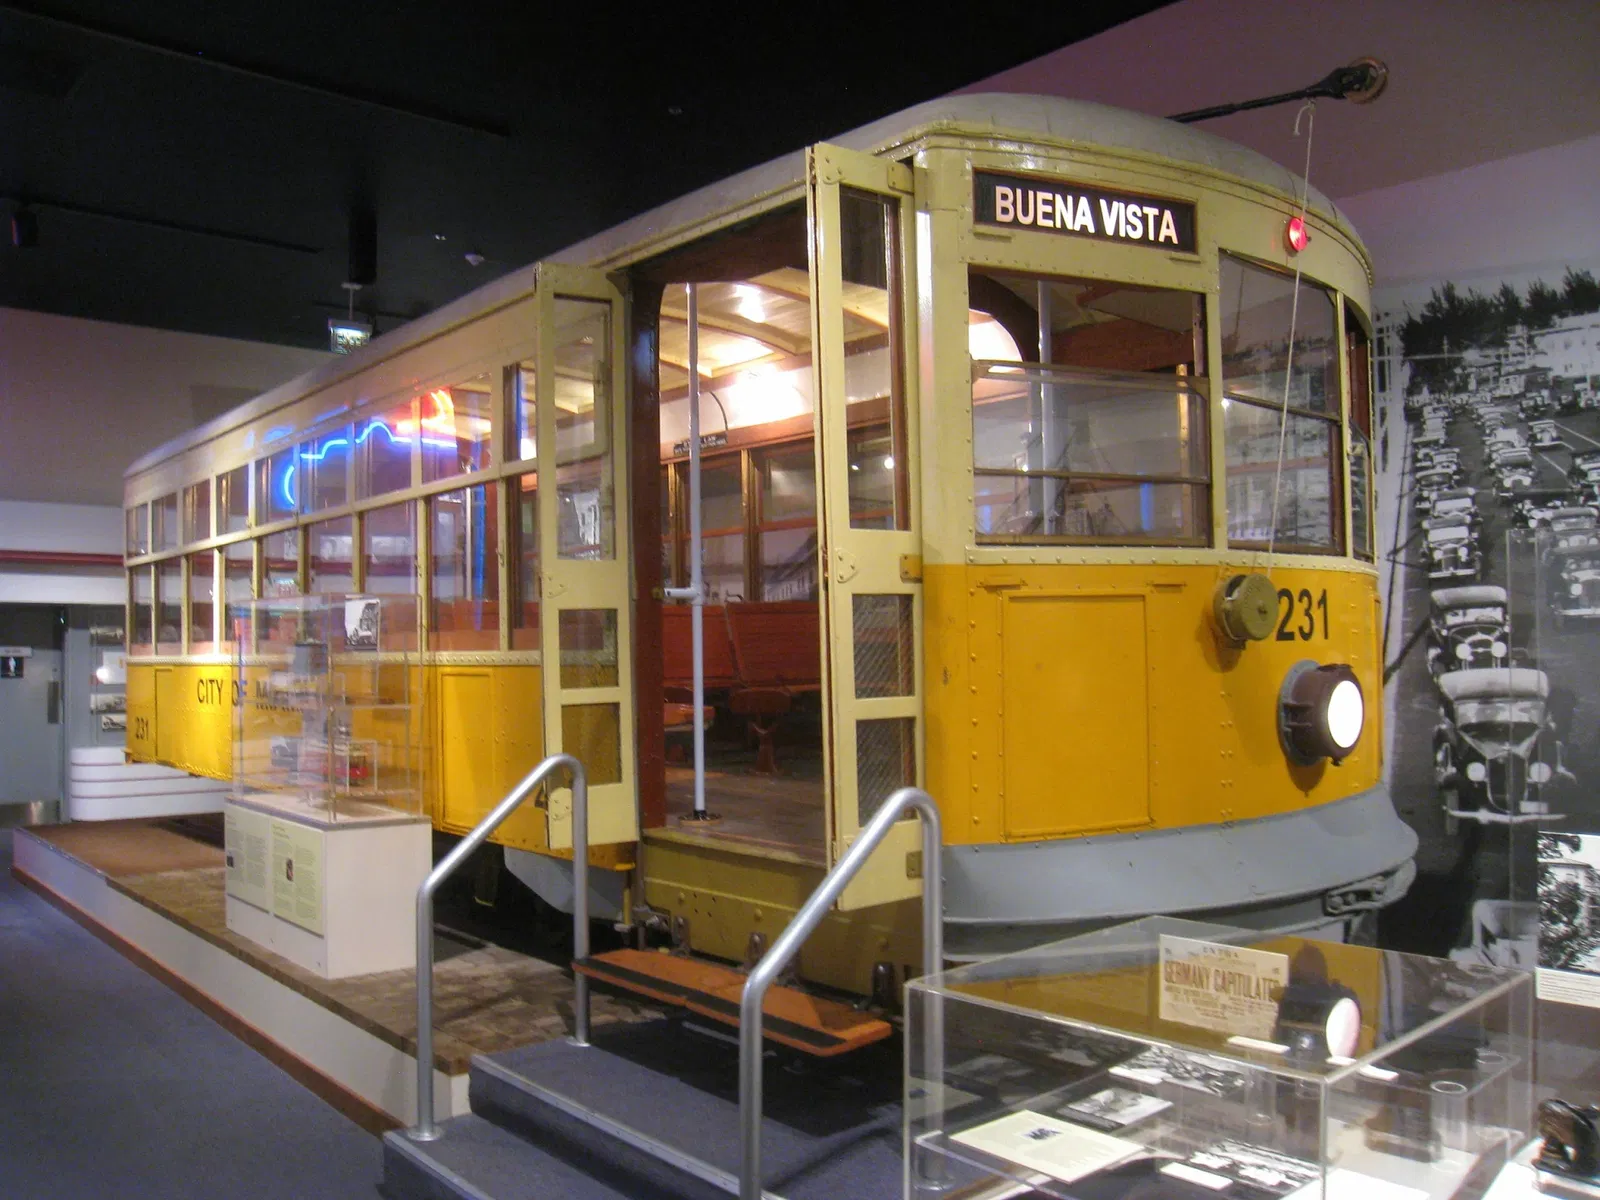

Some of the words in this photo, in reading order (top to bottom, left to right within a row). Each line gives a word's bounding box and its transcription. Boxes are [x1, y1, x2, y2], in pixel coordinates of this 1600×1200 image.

[995, 185, 1095, 233] BUENA
[1099, 198, 1179, 244] VISTA
[1276, 588, 1329, 641] 231
[197, 679, 224, 706] CITY
[135, 716, 149, 741] 231
[1165, 960, 1210, 990] GERMANY
